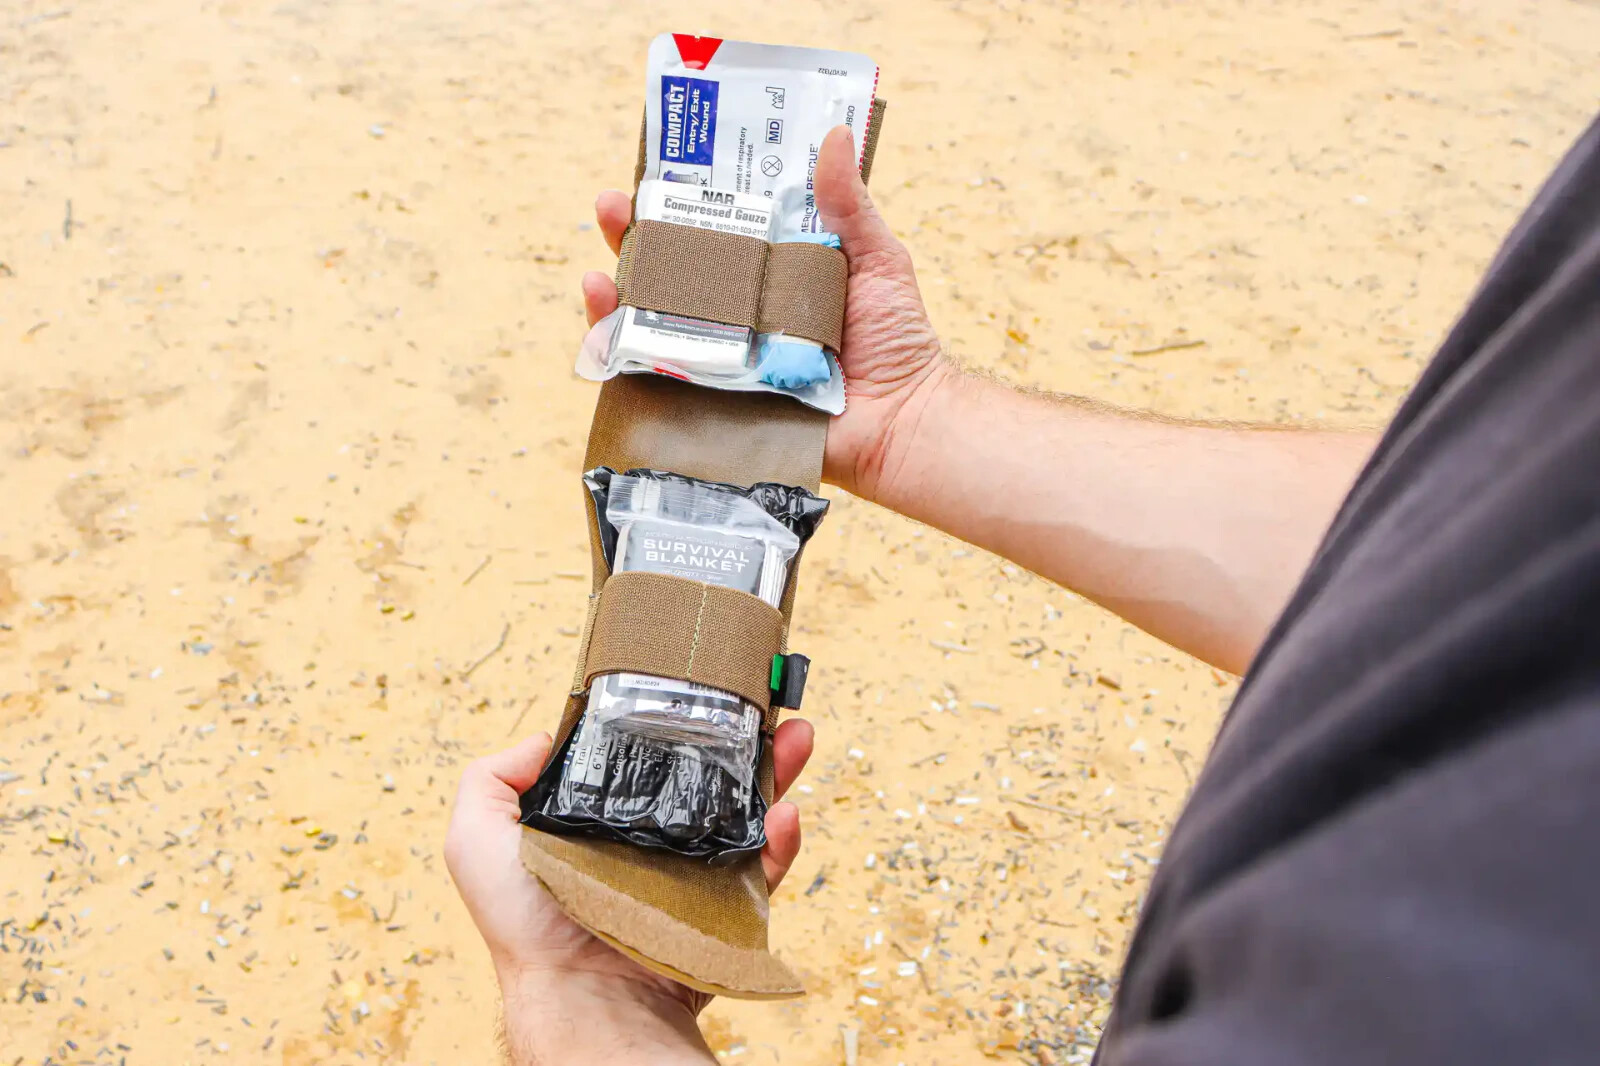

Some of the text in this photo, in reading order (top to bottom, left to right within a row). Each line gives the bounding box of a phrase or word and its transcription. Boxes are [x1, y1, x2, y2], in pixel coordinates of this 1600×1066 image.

[666, 84, 685, 158] COMPACT
[687, 88, 700, 153] Entry/Exit
[699, 101, 710, 143] Wound
[769, 121, 780, 141] MD
[738, 127, 747, 163] respiratory
[701, 190, 735, 205] NAR
[664, 198, 767, 224] Compressed Gauze
[700, 220, 713, 228] NSN
[643, 538, 750, 563] SURVIVAL
[645, 550, 746, 573] BLANKET
